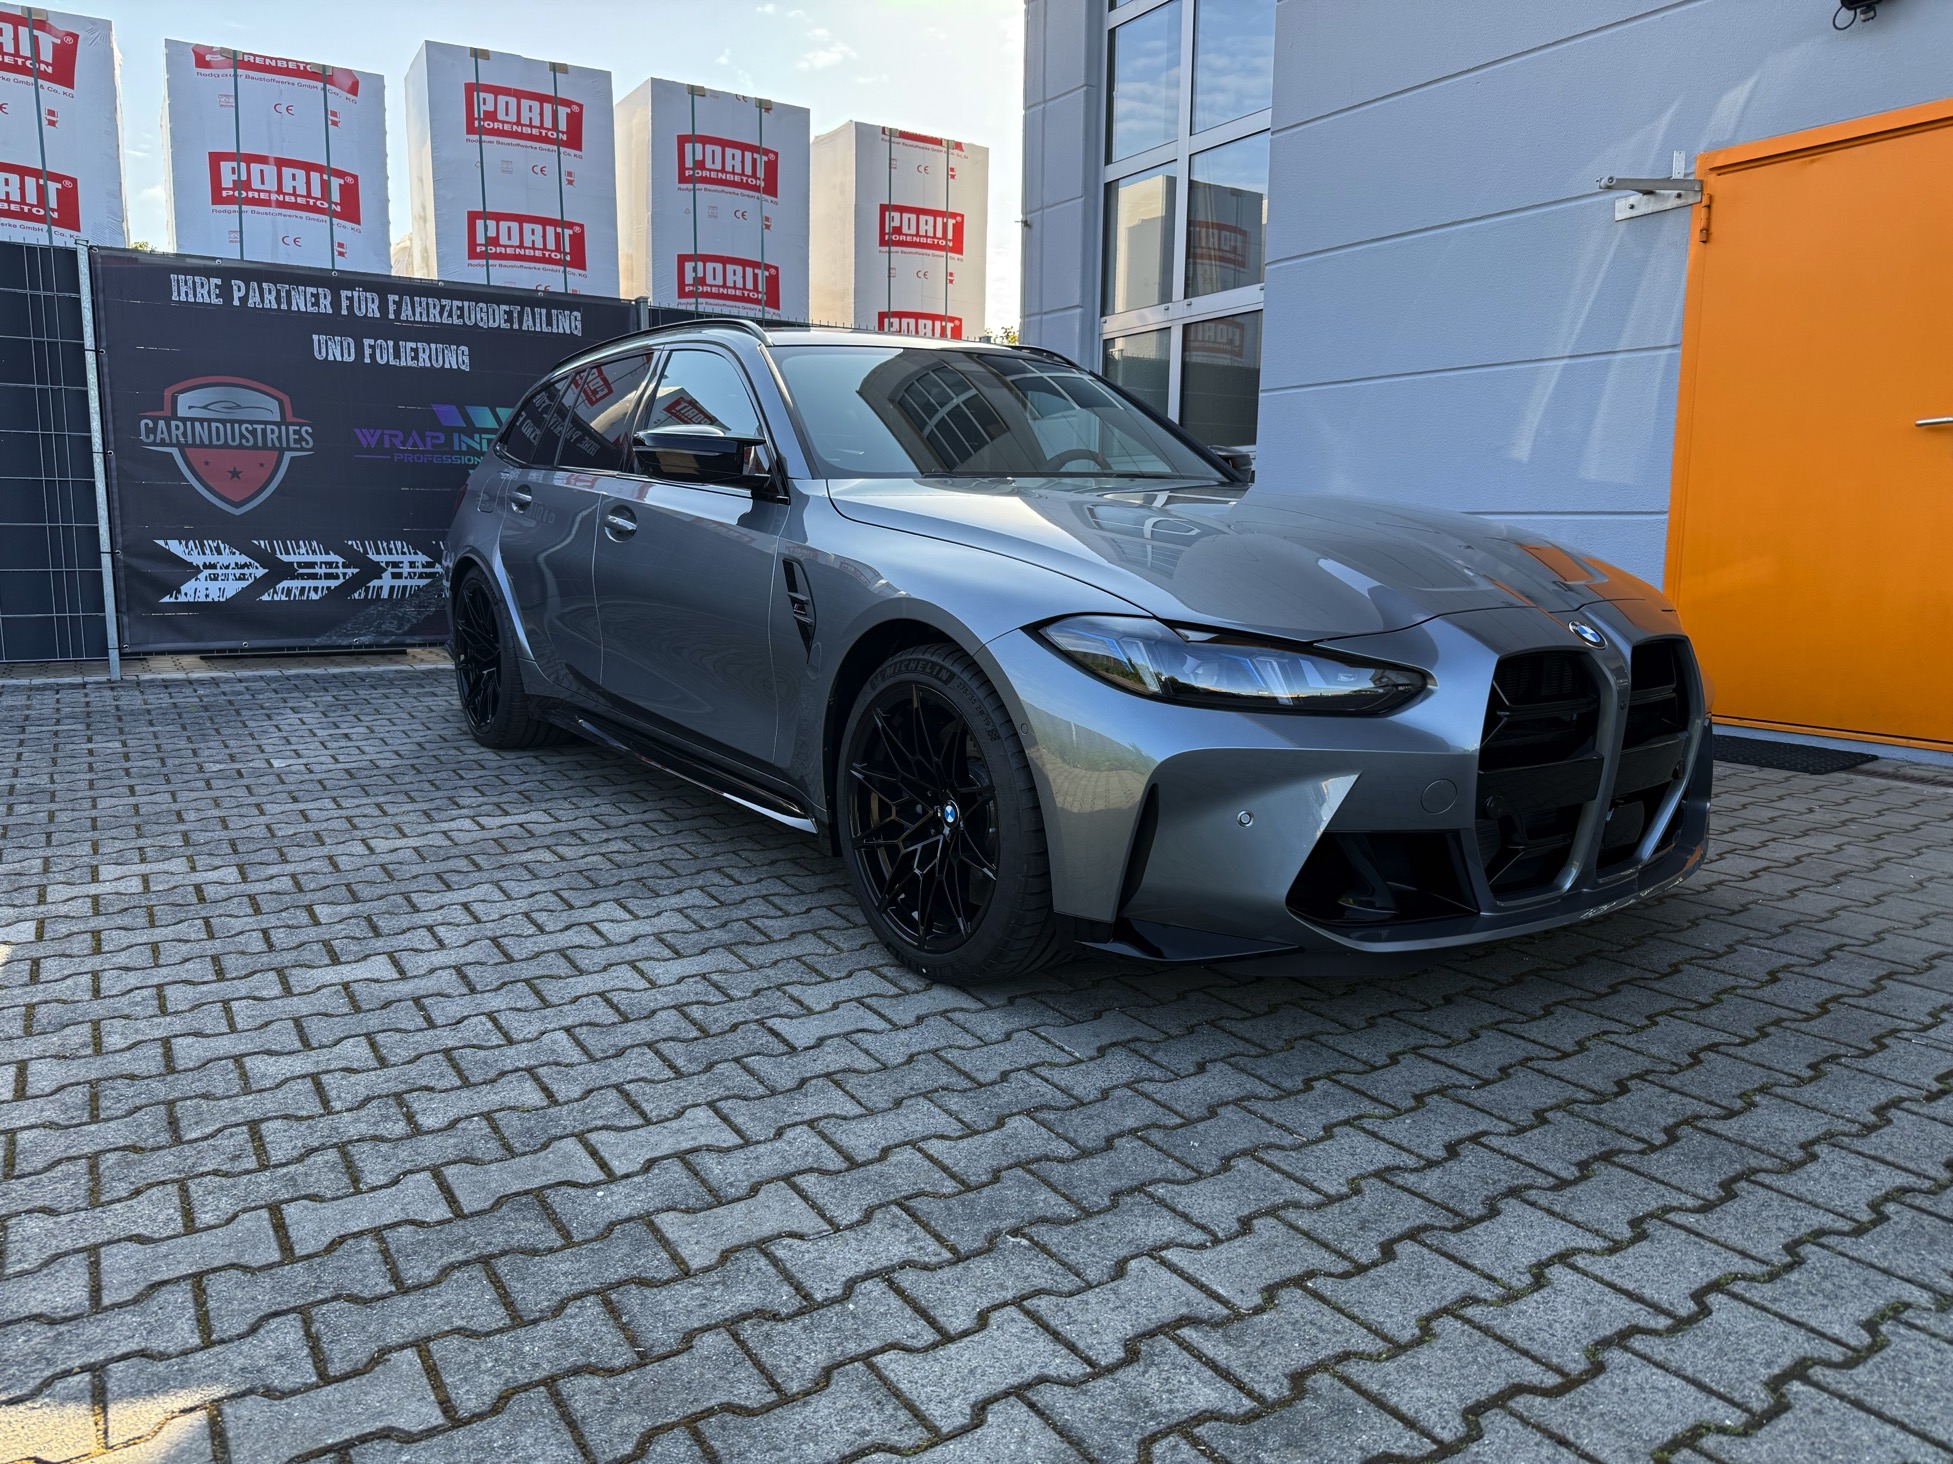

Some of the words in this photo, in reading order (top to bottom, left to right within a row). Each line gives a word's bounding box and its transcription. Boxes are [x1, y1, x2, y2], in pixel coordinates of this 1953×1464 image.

[0, 22, 61, 64] RIT
[62, 91, 75, 99] KG
[196, 71, 243, 80] Rodgaur
[245, 74, 296, 87] Baustoffwerke
[297, 82, 319, 91] GmbH
[346, 97, 358, 105] KG
[273, 102, 295, 116] CE
[473, 91, 572, 132] PORIT
[474, 120, 567, 141] PORENBETON
[496, 139, 538, 151] Baustoffwerke
[538, 146, 556, 154] GmbH
[573, 152, 583, 160] KG
[531, 164, 547, 177] CE
[684, 142, 768, 179] PORIT
[916, 164, 929, 175] CE
[220, 161, 345, 203] PORIT
[685, 169, 765, 188] PORENBETON
[0, 171, 62, 210] RIT
[222, 190, 341, 212] PORENBETON
[740, 192, 756, 200] GmbH
[0, 202, 59, 219] BETON
[734, 209, 748, 221] CE
[20, 224, 44, 233] GmbH
[251, 209, 303, 220] Baustoffwerke
[305, 215, 327, 224] GmbH
[351, 226, 362, 234] KG
[885, 211, 956, 240] PORIT
[281, 235, 302, 248] CE
[475, 219, 574, 253] PORIT
[476, 246, 571, 261] PORENBETON
[498, 263, 541, 272] Baustoffwerke
[542, 266, 561, 274] GmbH
[684, 261, 769, 292] PORIT
[916, 269, 929, 280] CE
[170, 273, 223, 305] IHRE
[231, 279, 333, 314] PARTNER
[340, 287, 381, 318] FÜR
[388, 294, 582, 337] FAHRZEUGDETAILING
[312, 334, 355, 364] UND
[363, 338, 470, 372] FOLIERUNG
[139, 418, 314, 449] CARINDUSTRIES
[353, 427, 446, 450] WRAP
[885, 660, 951, 681] MICHELIN
